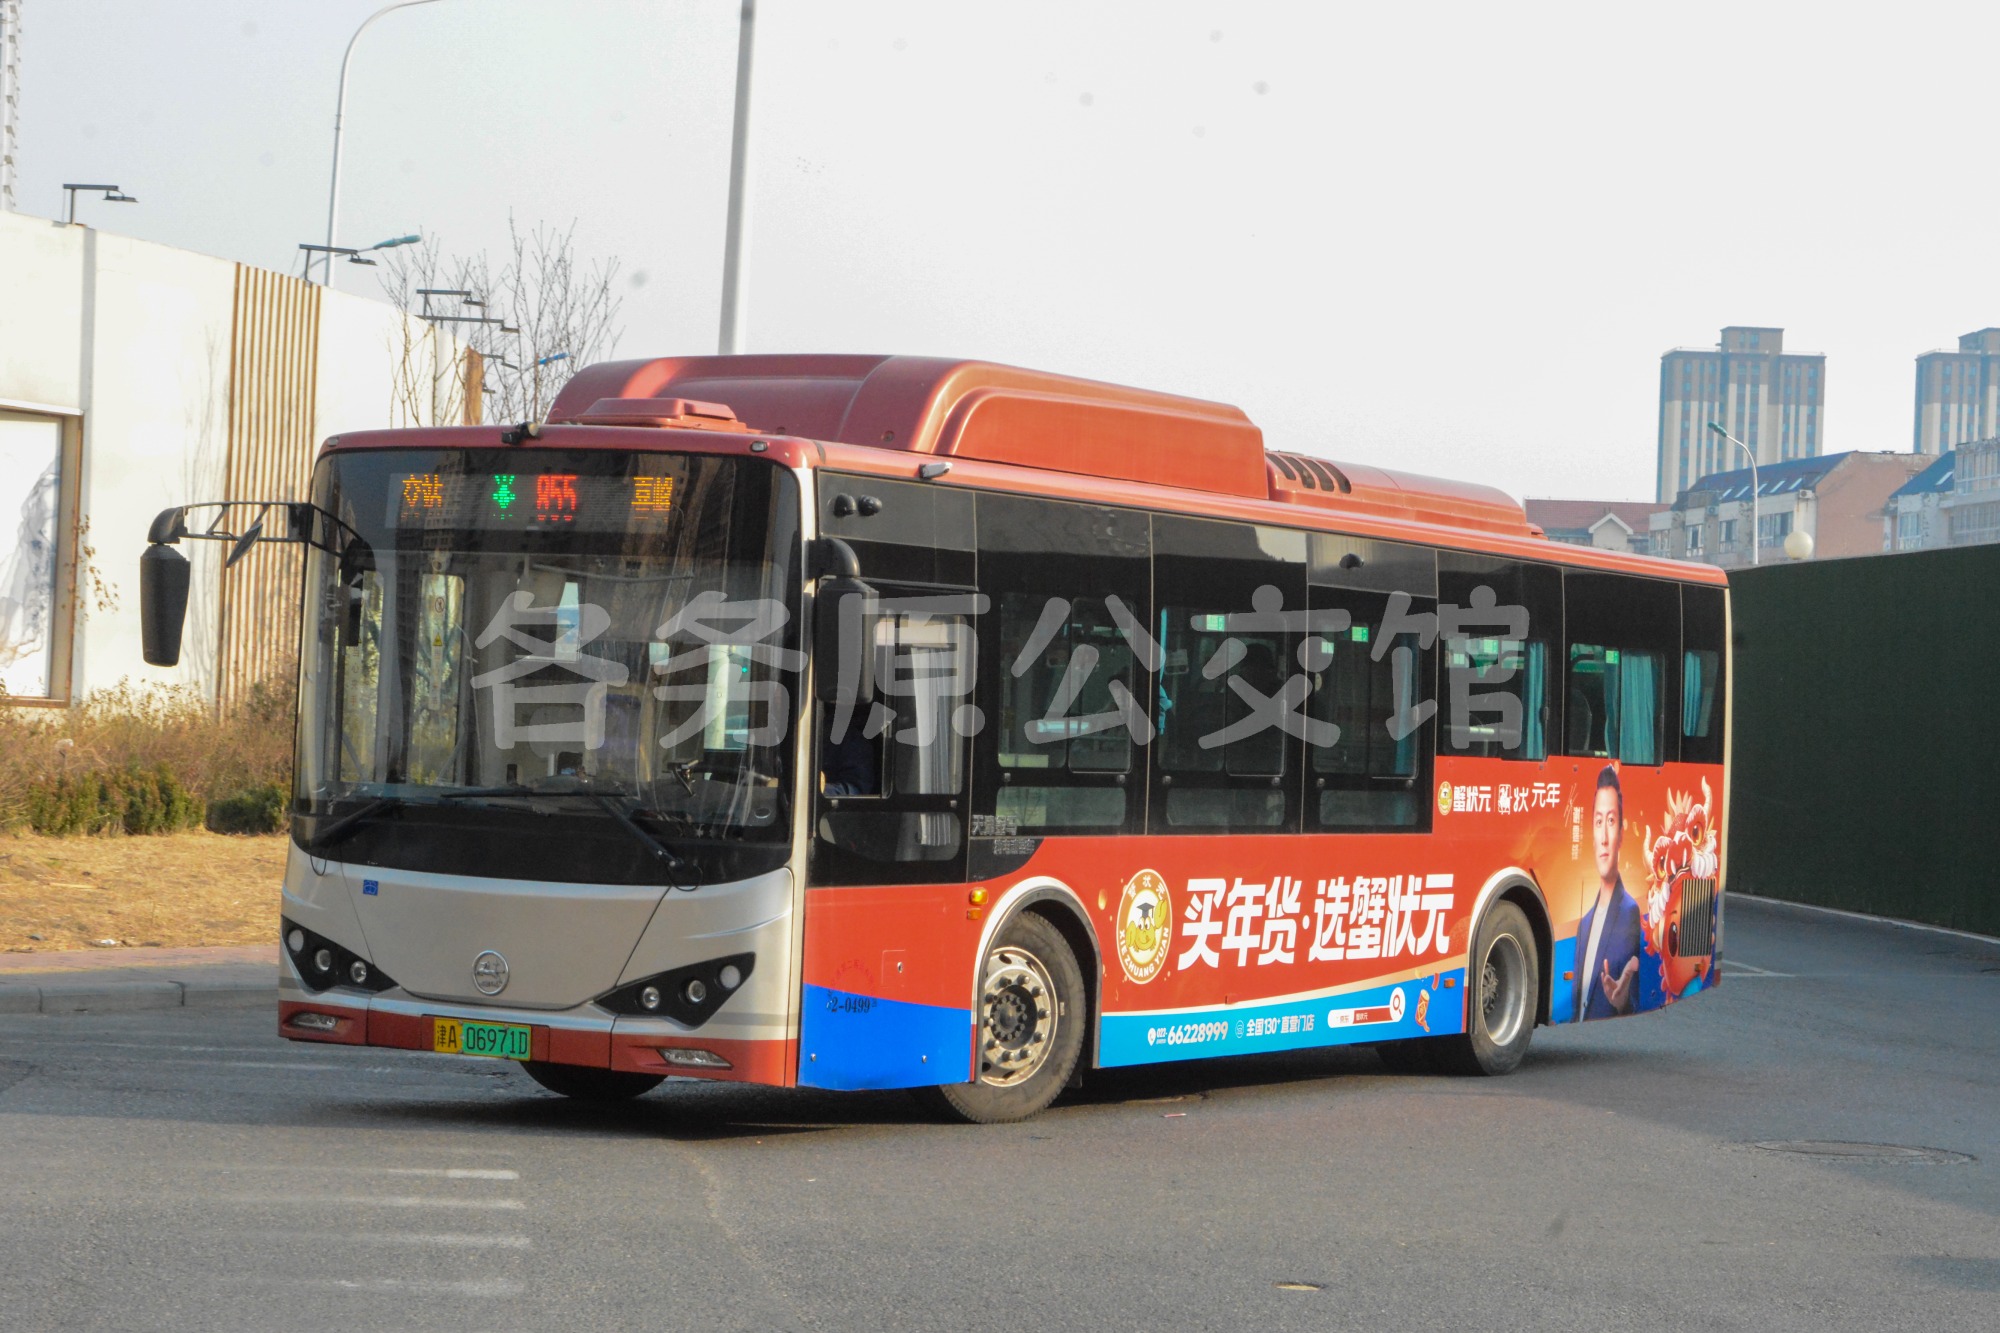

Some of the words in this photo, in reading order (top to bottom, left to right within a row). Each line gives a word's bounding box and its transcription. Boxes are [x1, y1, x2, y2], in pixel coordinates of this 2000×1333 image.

[537, 474, 577, 521] 855
[1453, 785, 1492, 813] 蟹状元
[1124, 956, 1155, 978] ZHUANG
[1154, 927, 1169, 965] YUAN
